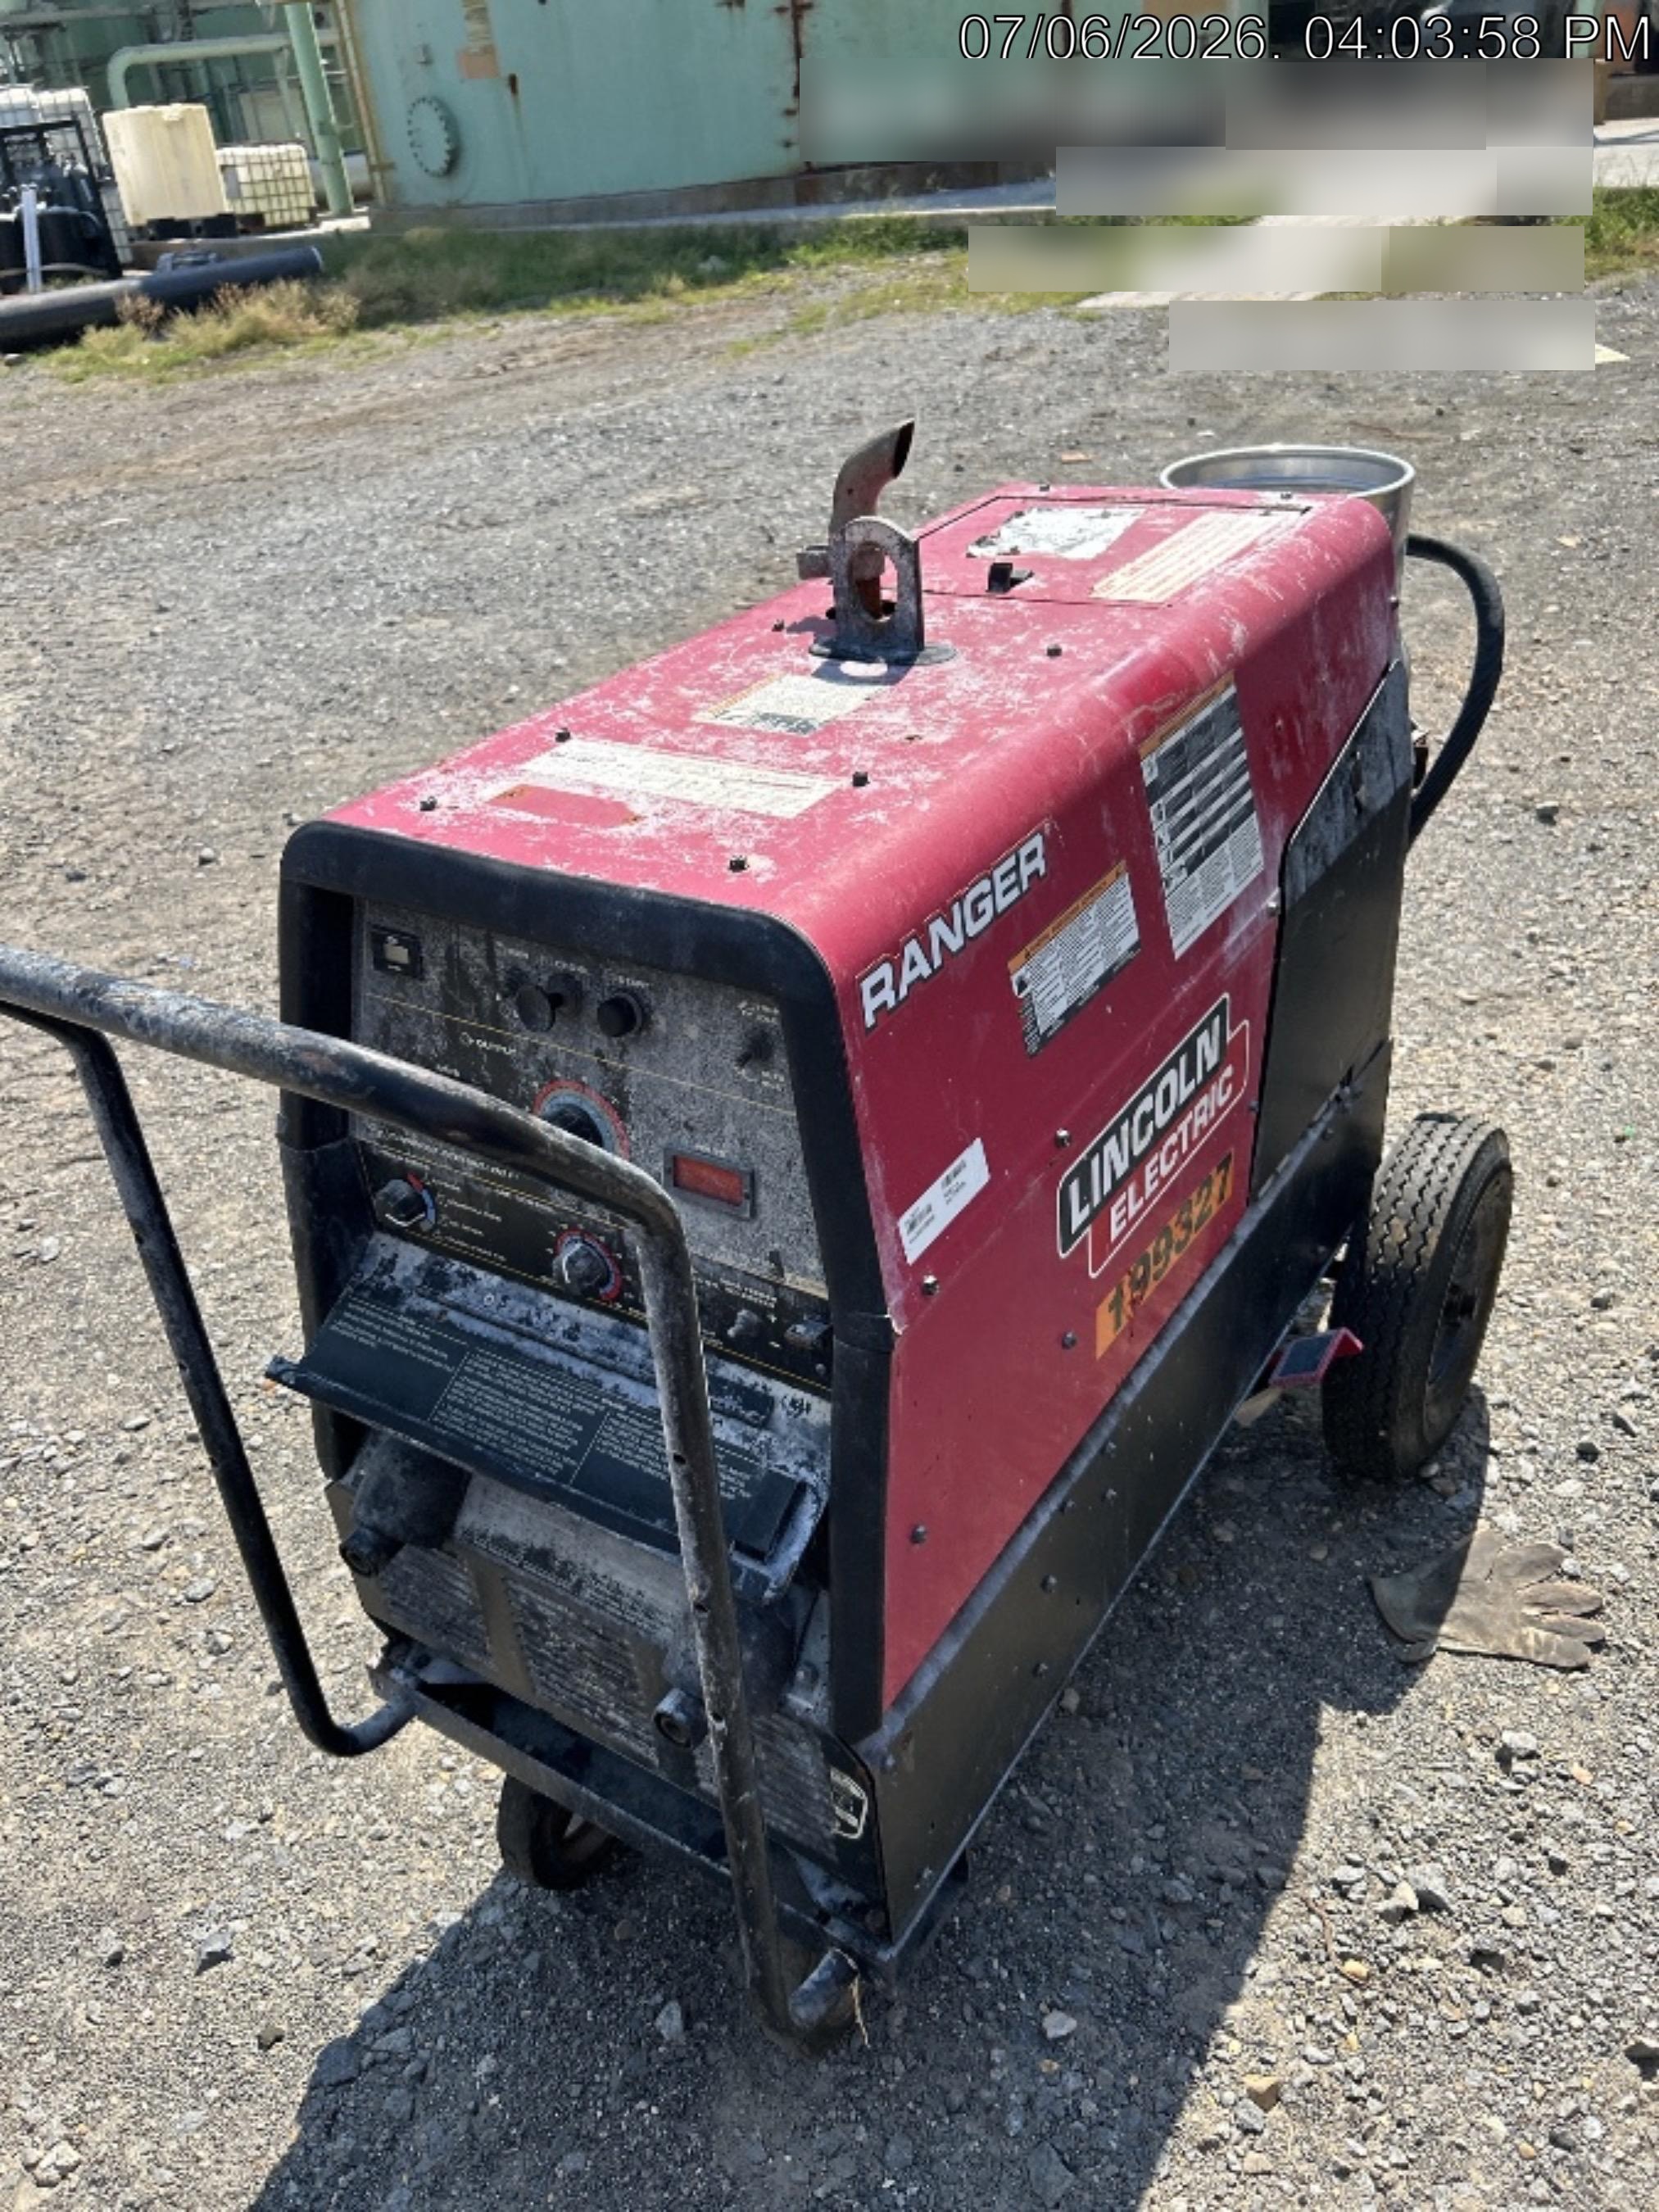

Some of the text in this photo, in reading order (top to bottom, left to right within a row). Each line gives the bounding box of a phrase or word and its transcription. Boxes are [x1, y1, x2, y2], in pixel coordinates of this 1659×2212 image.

[860, 832, 1046, 1029] RANGER
[1068, 1013, 1222, 1235] LINCOLN
[1110, 1064, 1234, 1243] ELECTRIC
[1108, 1151, 1233, 1336] 199327
